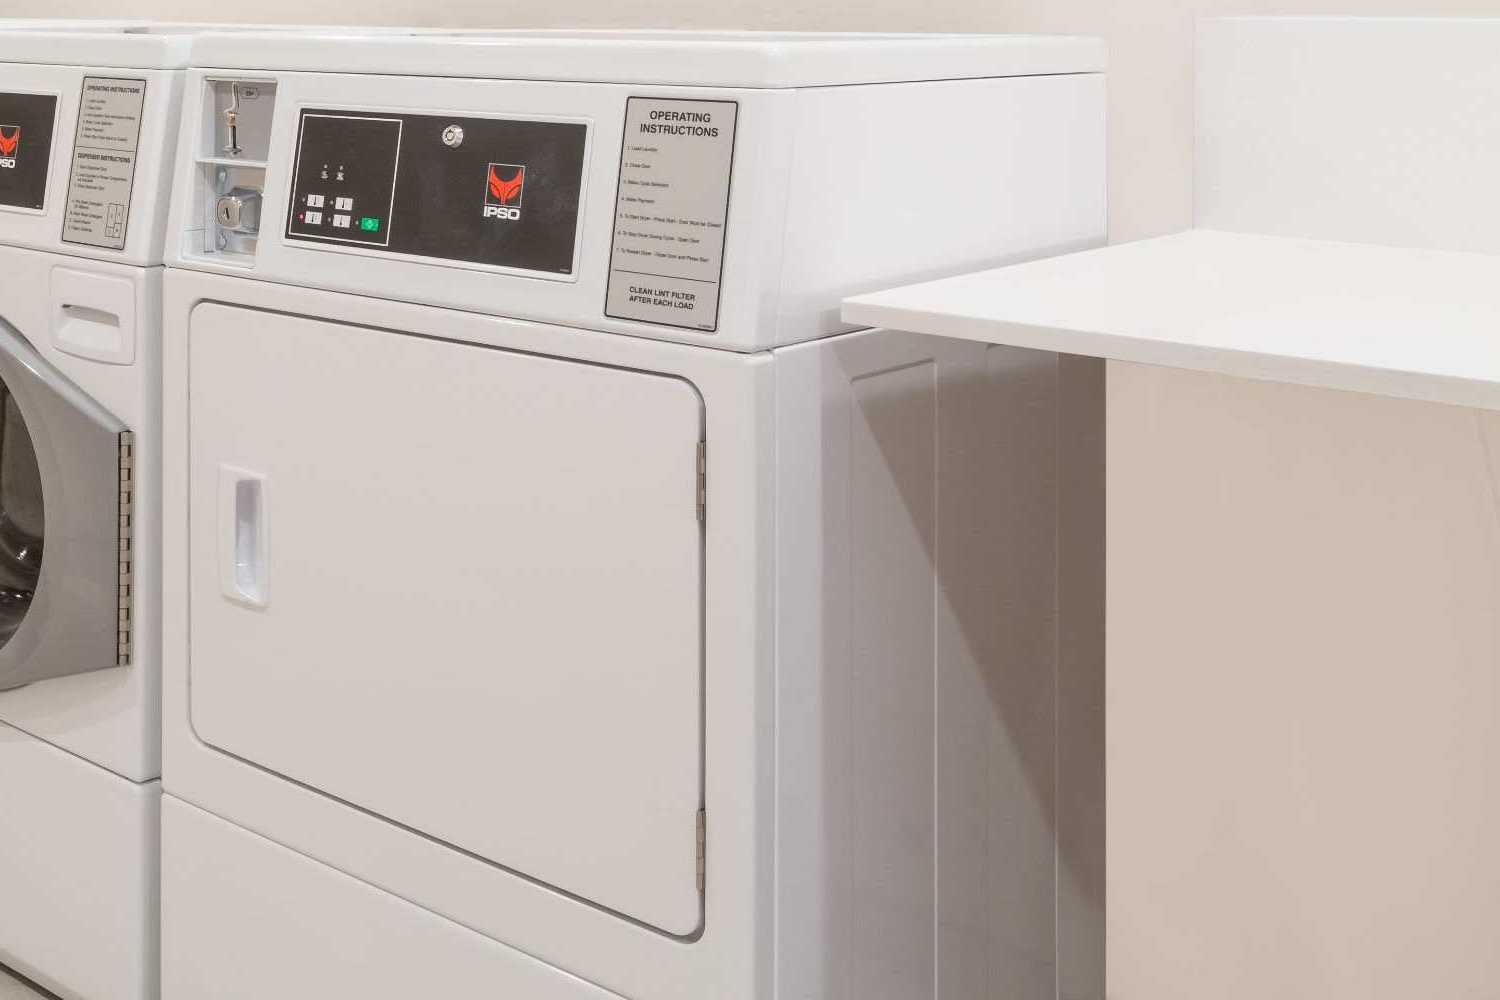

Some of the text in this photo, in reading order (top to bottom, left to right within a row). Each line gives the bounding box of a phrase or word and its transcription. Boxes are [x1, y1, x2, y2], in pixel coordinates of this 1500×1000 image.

[650, 111, 711, 123] OPERATING
[640, 124, 719, 137] INSTRUCTIONS
[483, 205, 521, 221] IPSO
[629, 286, 695, 301] CLEAN LINT FILTER
[628, 295, 694, 310] AFTER EACH LOAD
